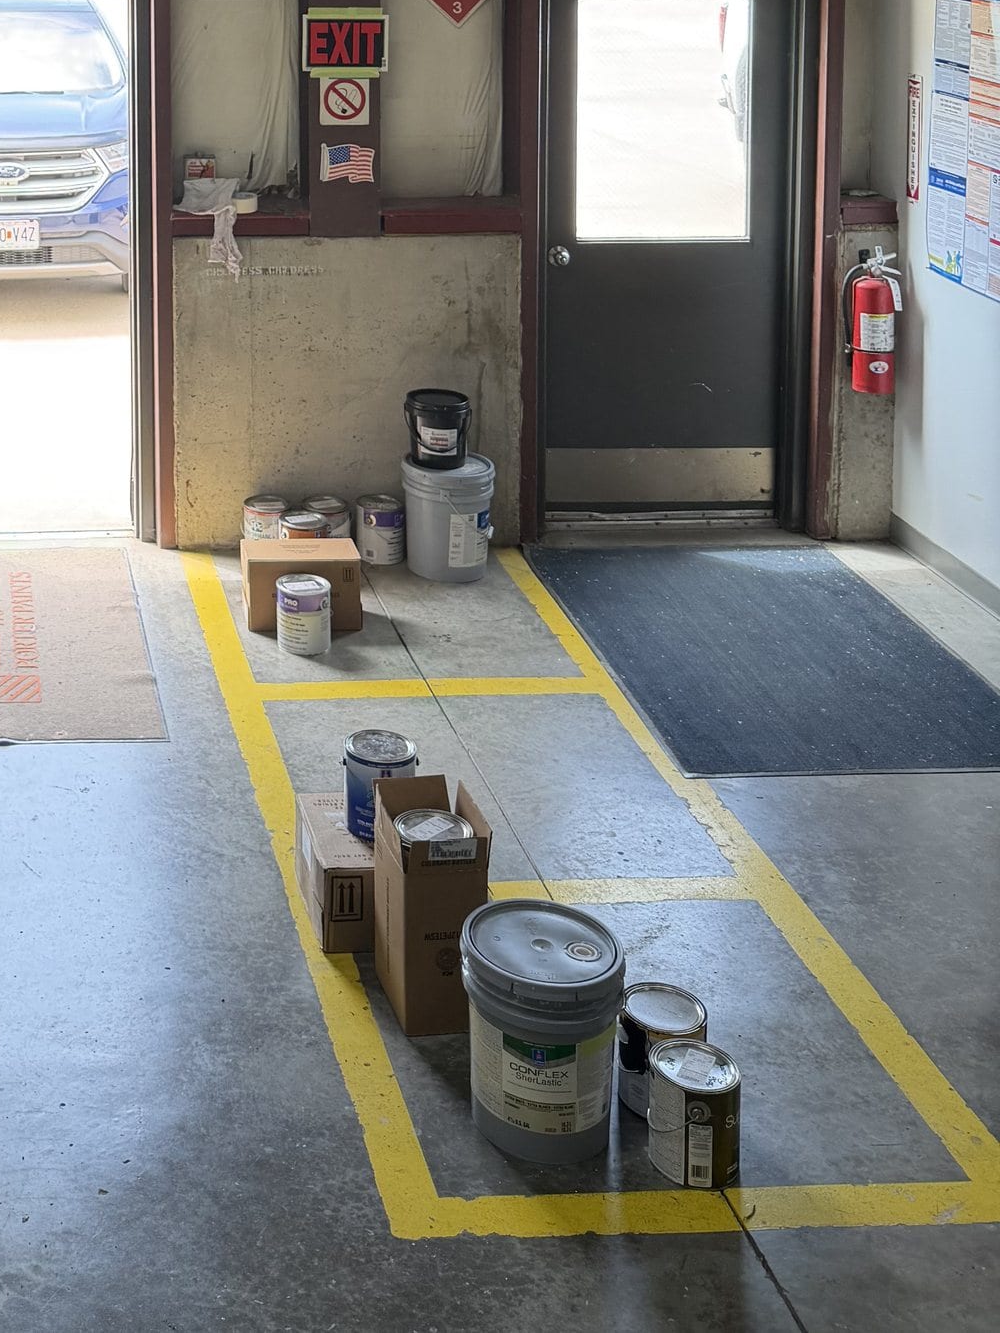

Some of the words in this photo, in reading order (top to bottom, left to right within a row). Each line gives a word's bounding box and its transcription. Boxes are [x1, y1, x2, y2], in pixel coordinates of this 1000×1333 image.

[452, 0, 463, 14] 3
[309, 21, 384, 65] EXIT
[12, 227, 36, 242] V4Z
[8, 570, 34, 616] PAINTS
[283, 597, 298, 608] PRO
[12, 617, 40, 670] PORTER
[508, 1061, 569, 1080] CONFLEX
[515, 1071, 563, 1087] SherLastic
